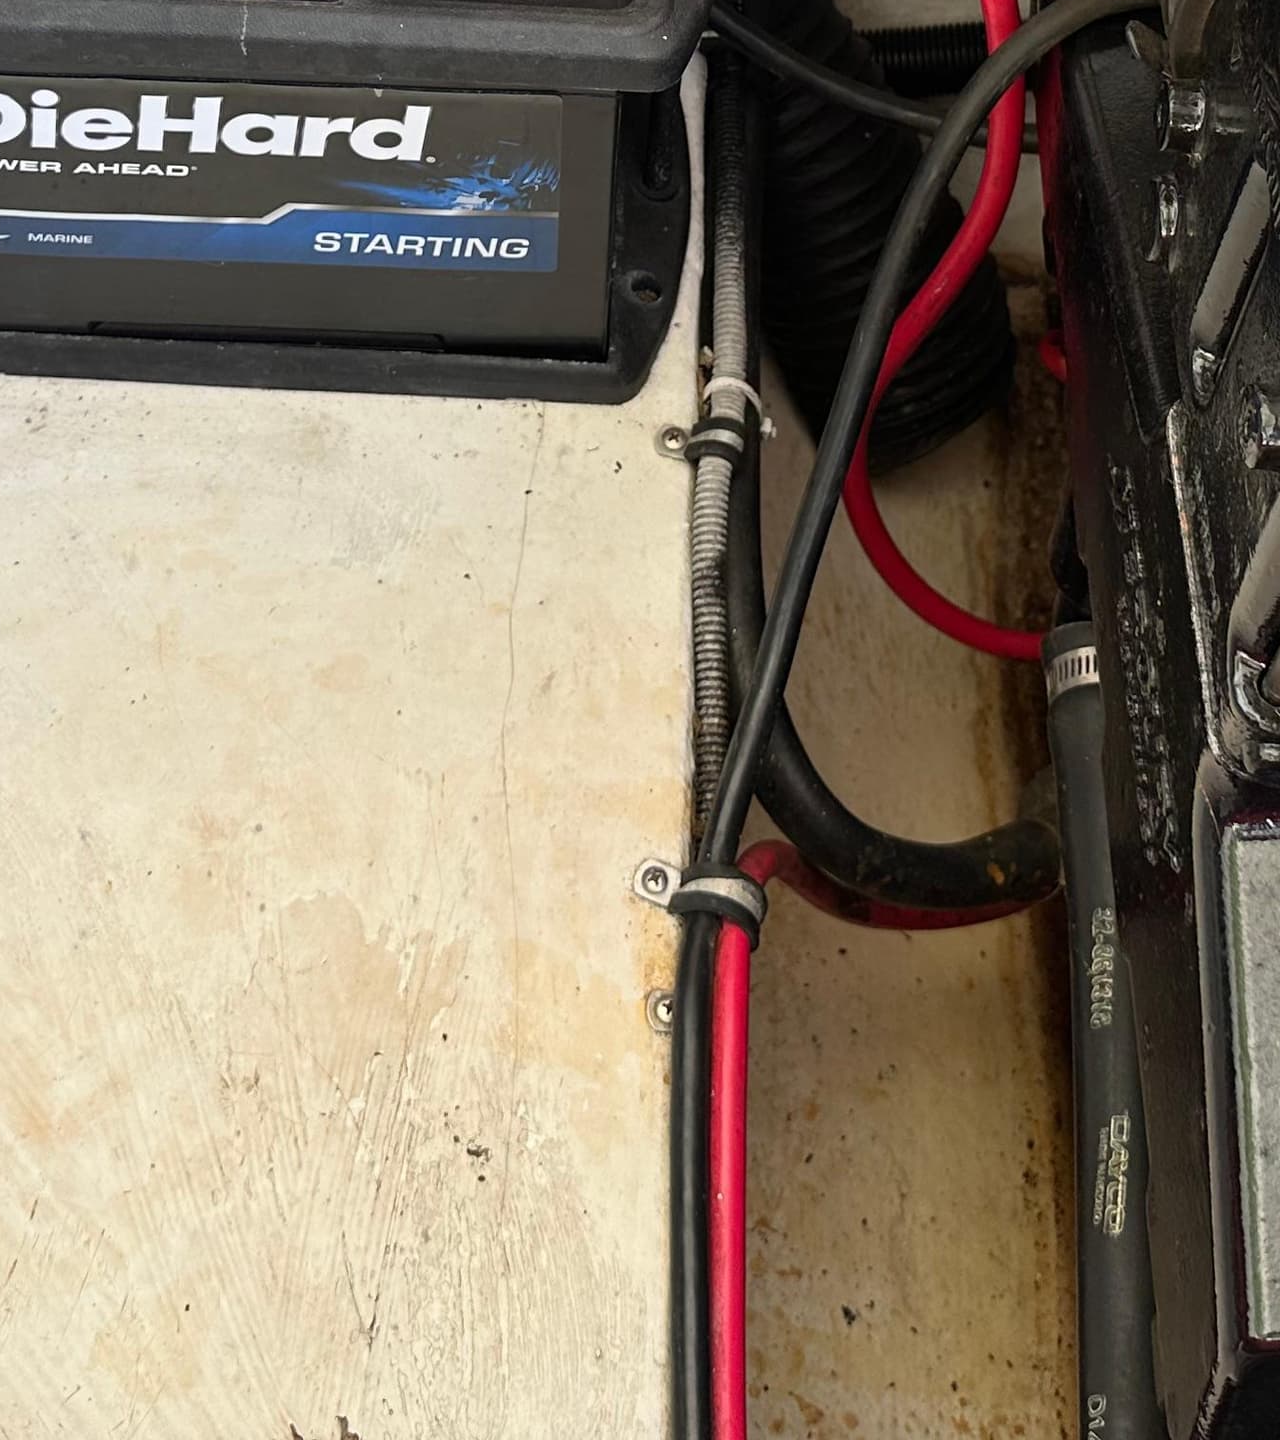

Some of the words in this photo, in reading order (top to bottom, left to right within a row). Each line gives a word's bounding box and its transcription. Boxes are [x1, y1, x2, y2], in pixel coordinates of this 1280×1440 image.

[27, 232, 94, 245] MARINE
[312, 231, 531, 261] STARTING
[1101, 1111, 1131, 1237] DAYCO
